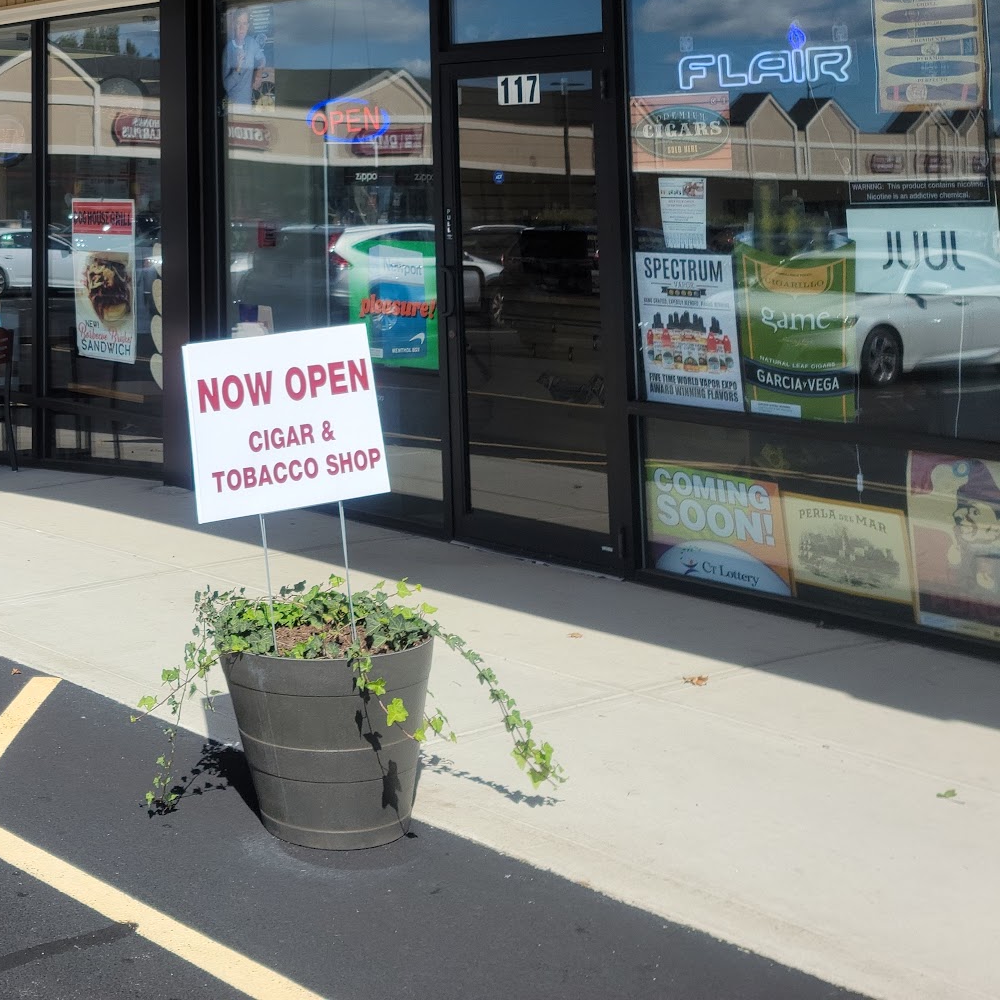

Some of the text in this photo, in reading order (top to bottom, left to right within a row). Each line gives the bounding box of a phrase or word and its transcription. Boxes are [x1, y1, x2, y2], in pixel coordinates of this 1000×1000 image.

[678, 45, 851, 90] FLAIR
[501, 75, 537, 104] 117
[311, 106, 380, 136] OPEN
[642, 120, 723, 139] CIGARS
[888, 182, 900, 190] This
[902, 182, 926, 191] product
[909, 191, 938, 199] addictive
[882, 230, 966, 271] JUUL
[383, 257, 422, 276] Newport
[643, 256, 724, 283] SPECTRUM
[358, 293, 437, 319] pleasure!
[761, 306, 831, 334] game
[81, 339, 130, 356] SANDWICH
[759, 355, 790, 368] NATURAL
[197, 358, 369, 413] NOW OPEN
[649, 373, 737, 390] FIVE TIME WORLD VAPOR EXPO
[650, 383, 738, 402] AWARD WINNING FLAVORS
[756, 368, 802, 391] GARCIA
[808, 376, 840, 391] VEGA
[249, 420, 336, 453] CIGAR &
[212, 448, 381, 493] TOBACCO SHOP
[653, 467, 771, 512] COMING
[656, 494, 776, 546] SOON!
[799, 507, 837, 520] PERLA
[855, 514, 887, 534] MAR
[720, 565, 760, 587] Lottery
